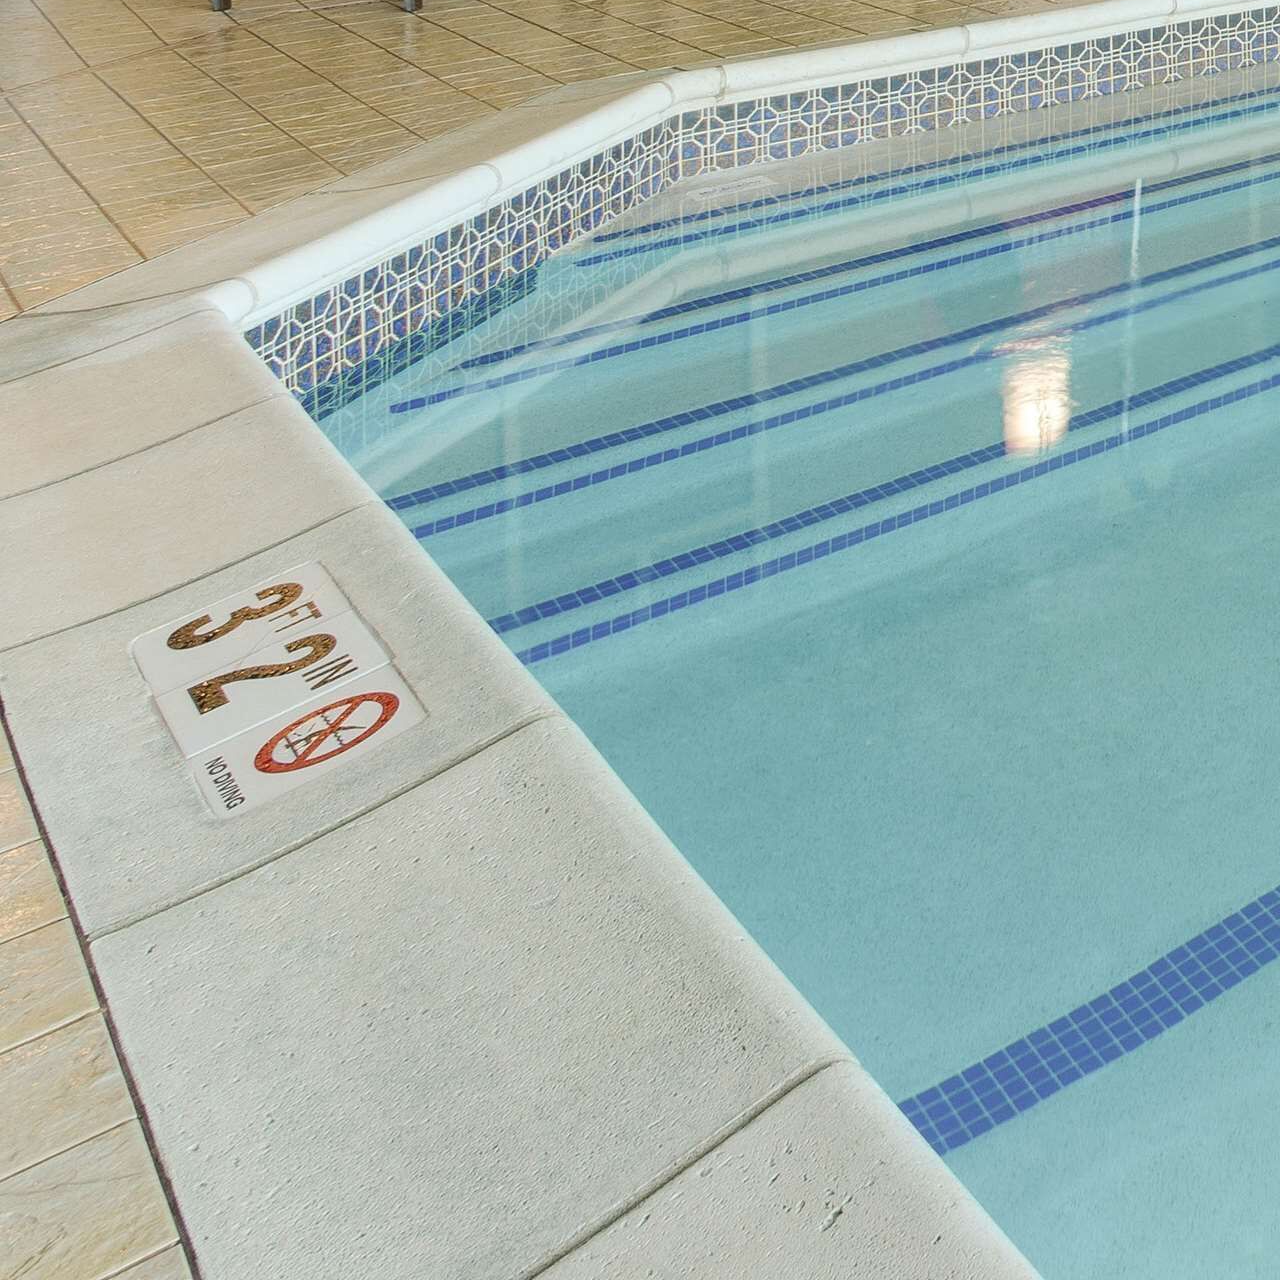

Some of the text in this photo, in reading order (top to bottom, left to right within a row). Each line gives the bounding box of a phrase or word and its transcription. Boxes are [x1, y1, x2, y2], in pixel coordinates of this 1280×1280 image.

[166, 581, 324, 650] 3 FT
[186, 633, 359, 715] 2 IN
[204, 755, 246, 811] NO DIVING
